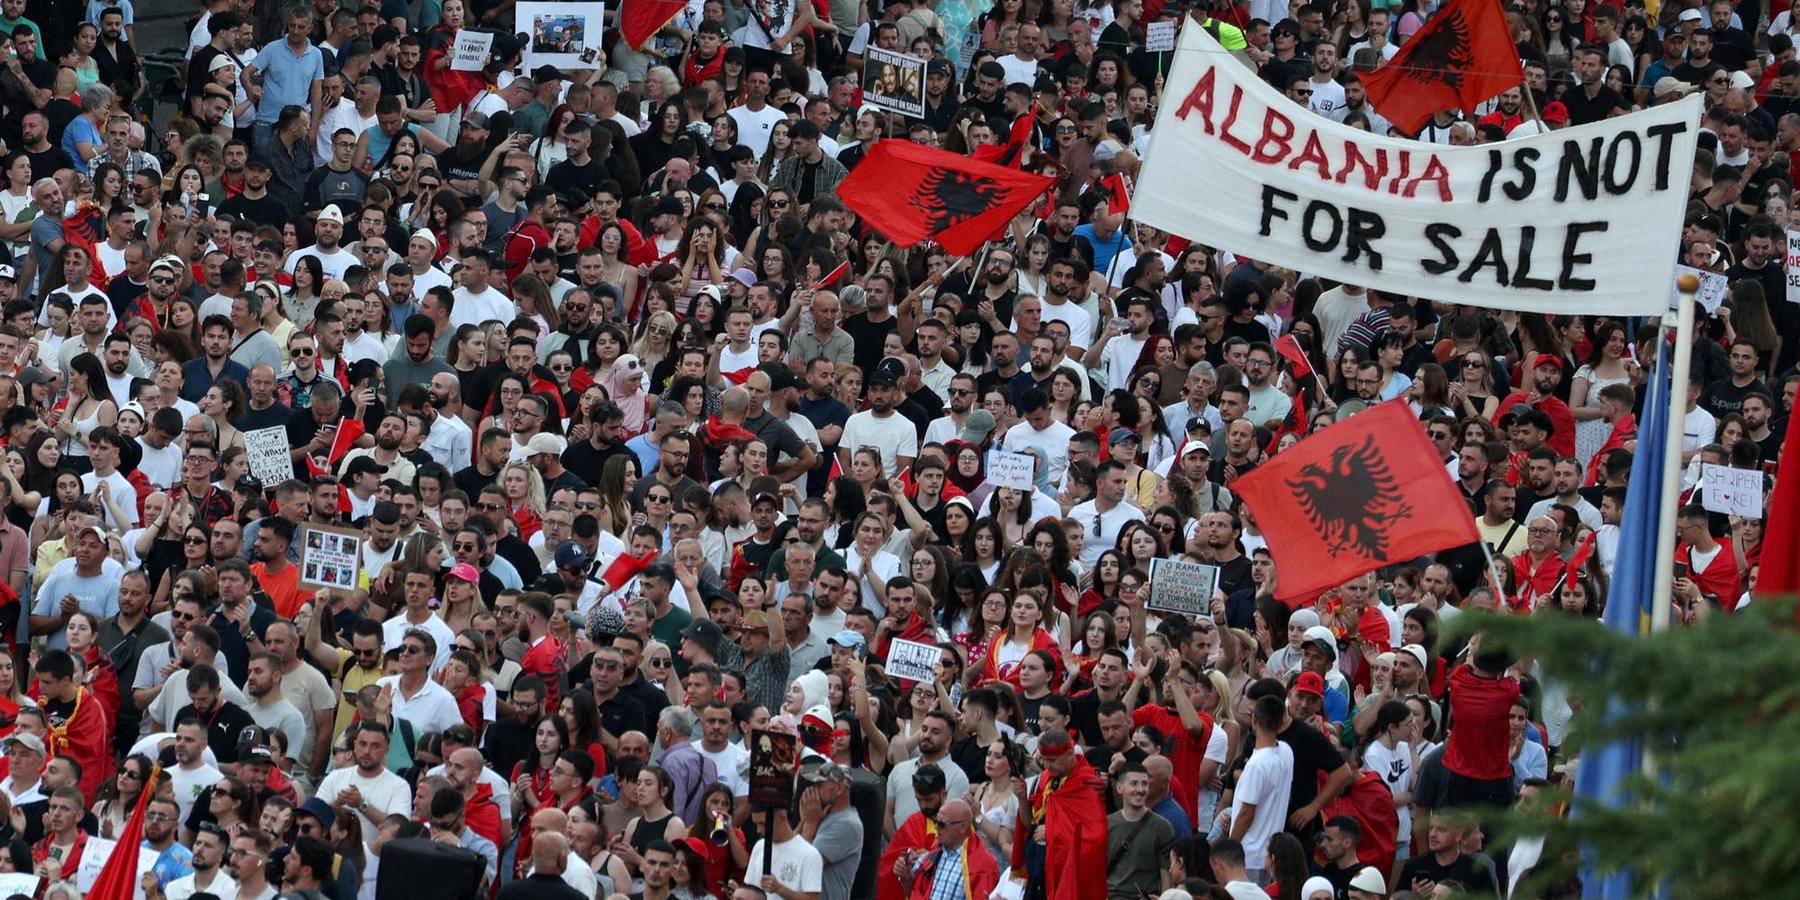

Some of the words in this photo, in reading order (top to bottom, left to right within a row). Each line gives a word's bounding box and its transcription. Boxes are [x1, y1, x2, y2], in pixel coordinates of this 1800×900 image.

[1174, 65, 1454, 202] ALBANIA
[1477, 149, 1541, 204] IS
[1554, 121, 1688, 202] NOT
[1260, 184, 1386, 270] FOR
[1420, 220, 1609, 292] SALE
[1712, 489, 1721, 502] E
[1176, 562, 1199, 573] RAMA
